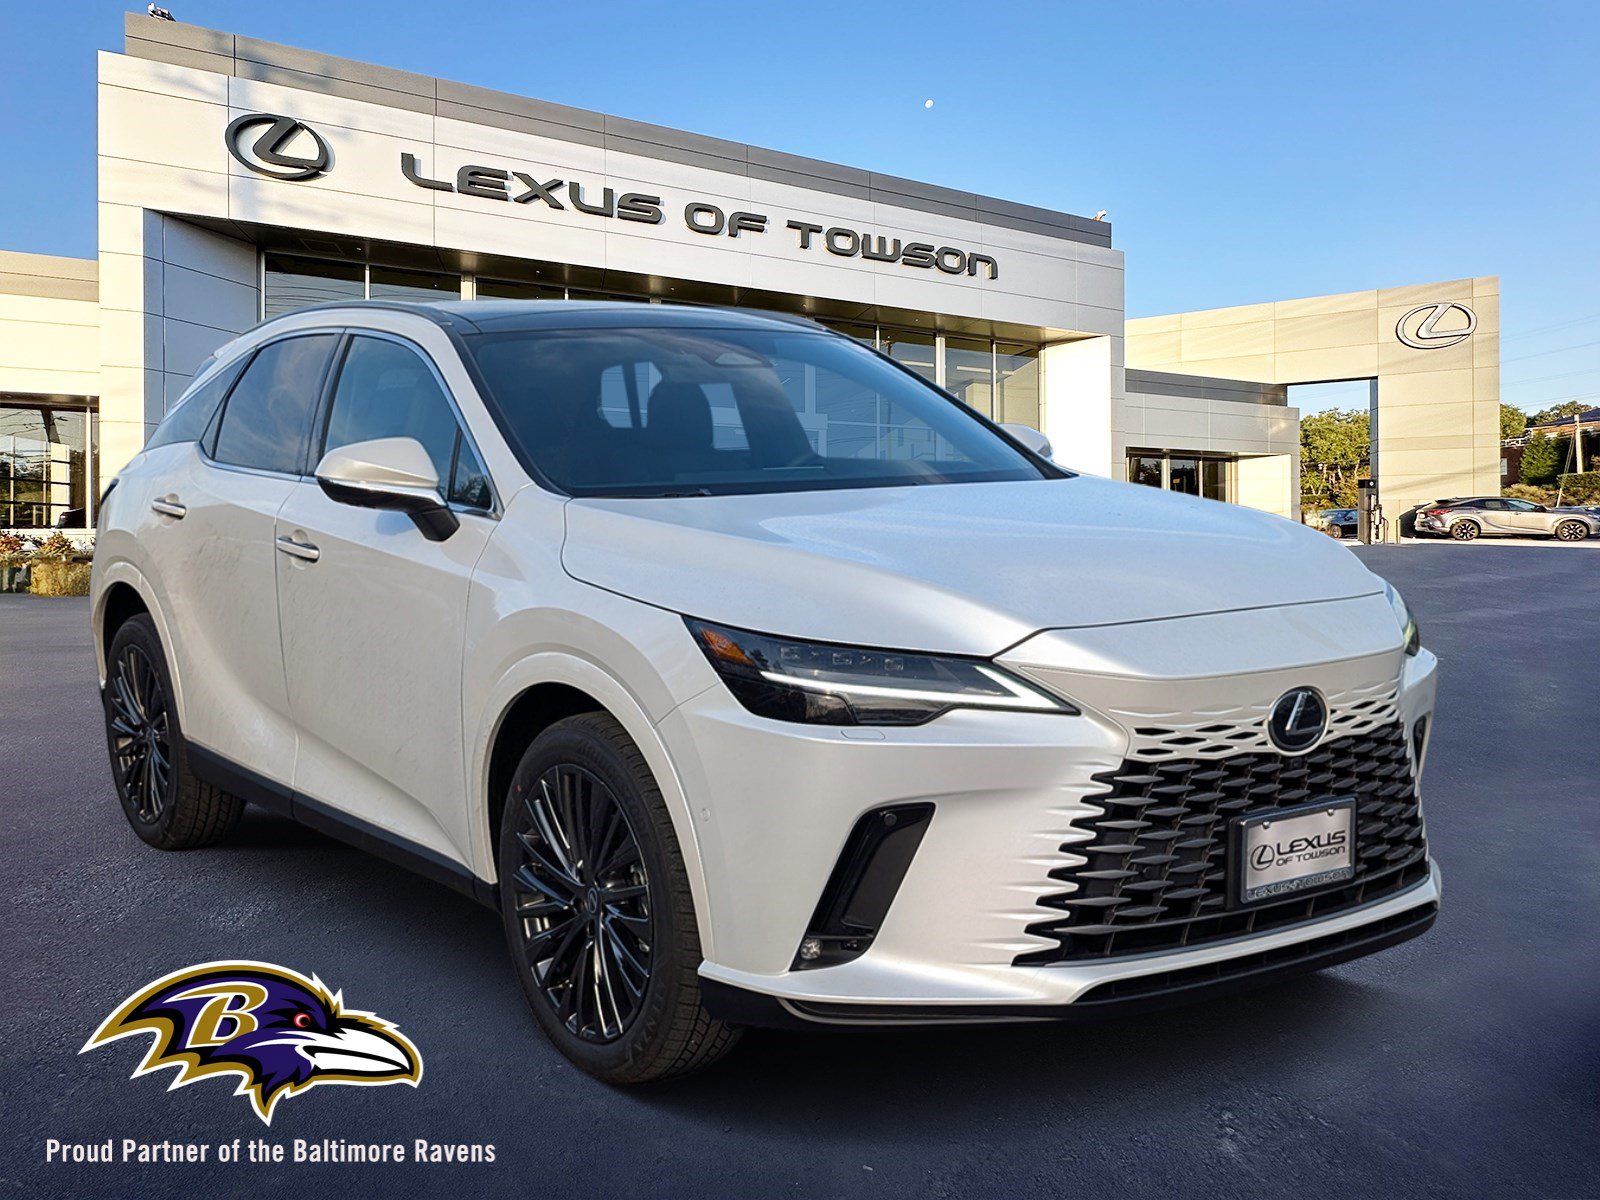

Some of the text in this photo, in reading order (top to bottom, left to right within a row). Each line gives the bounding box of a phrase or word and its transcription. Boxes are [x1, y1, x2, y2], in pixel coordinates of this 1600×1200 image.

[401, 152, 999, 280] LEXUS OF TOWSON
[1275, 845, 1346, 867] OF TOWSON
[1276, 829, 1346, 856] LEXUS
